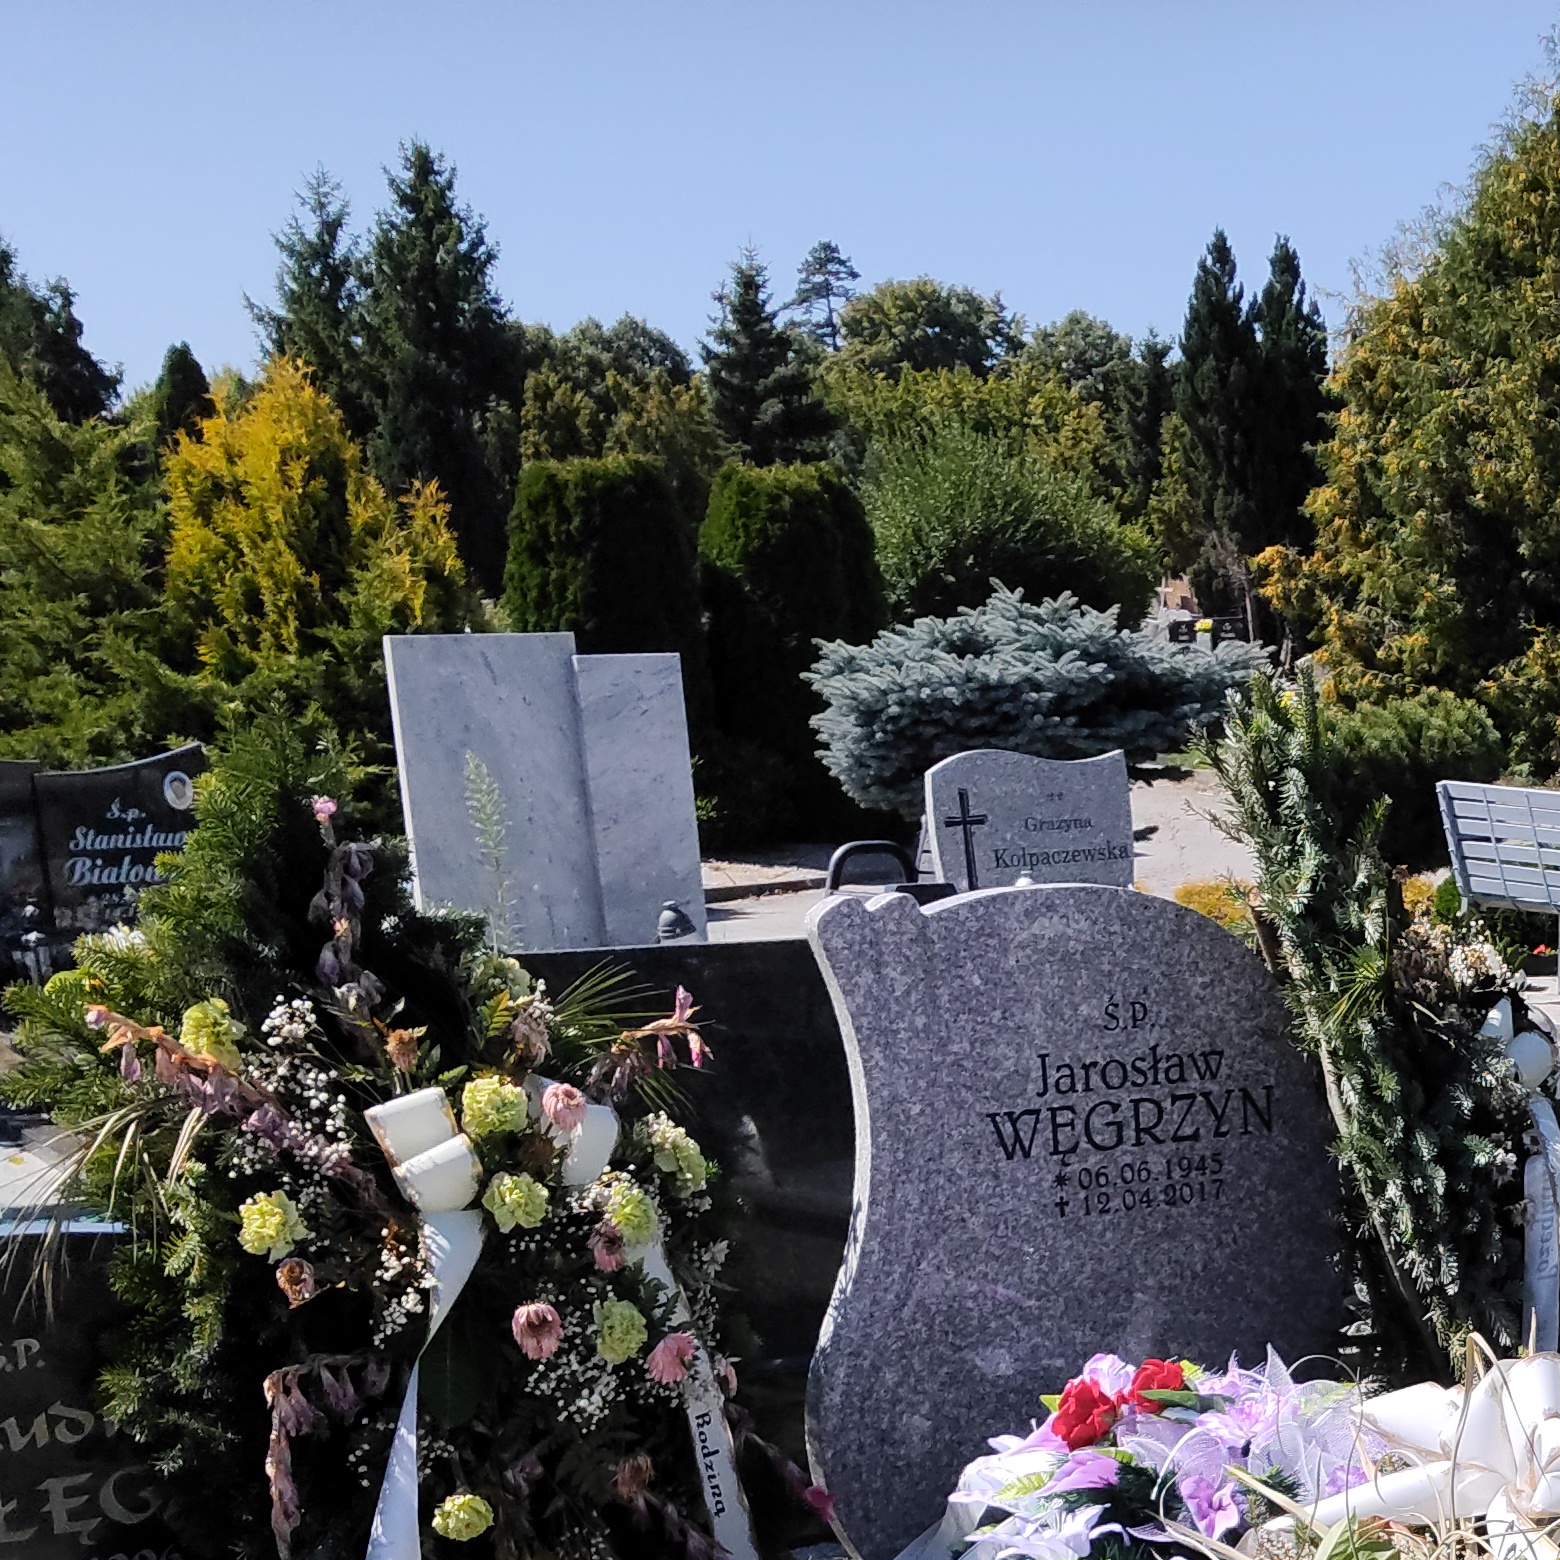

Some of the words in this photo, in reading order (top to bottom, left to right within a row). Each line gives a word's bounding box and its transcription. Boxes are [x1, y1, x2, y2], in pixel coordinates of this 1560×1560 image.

[1036, 1044, 1224, 1098] Jarosław
[986, 1085, 1275, 1166] WĘGRZYN
[1077, 1153, 1223, 1190] 06.06.1945
[1083, 1179, 1223, 1216] 12.04.2017
